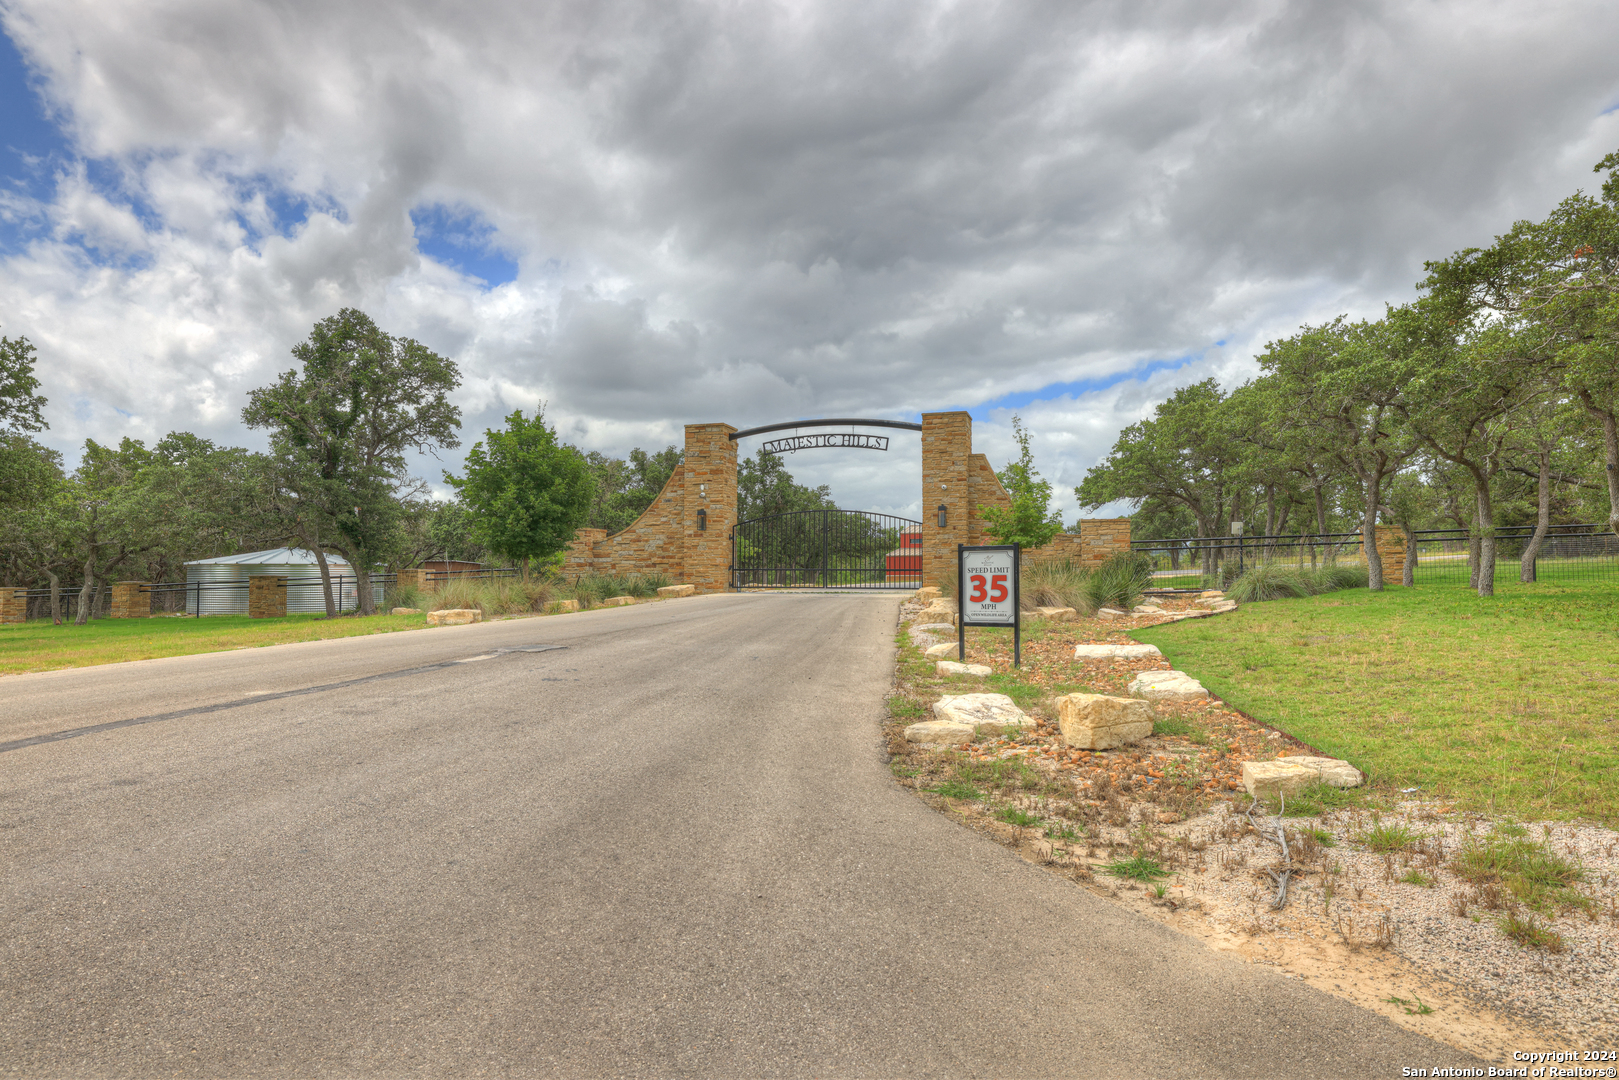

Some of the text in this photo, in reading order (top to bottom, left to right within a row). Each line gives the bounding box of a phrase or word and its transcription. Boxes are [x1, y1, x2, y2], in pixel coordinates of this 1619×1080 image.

[771, 434, 882, 454] MAJESTIC HILLS
[967, 566, 1010, 574] SPEED LIMIT
[969, 574, 1009, 603] 35
